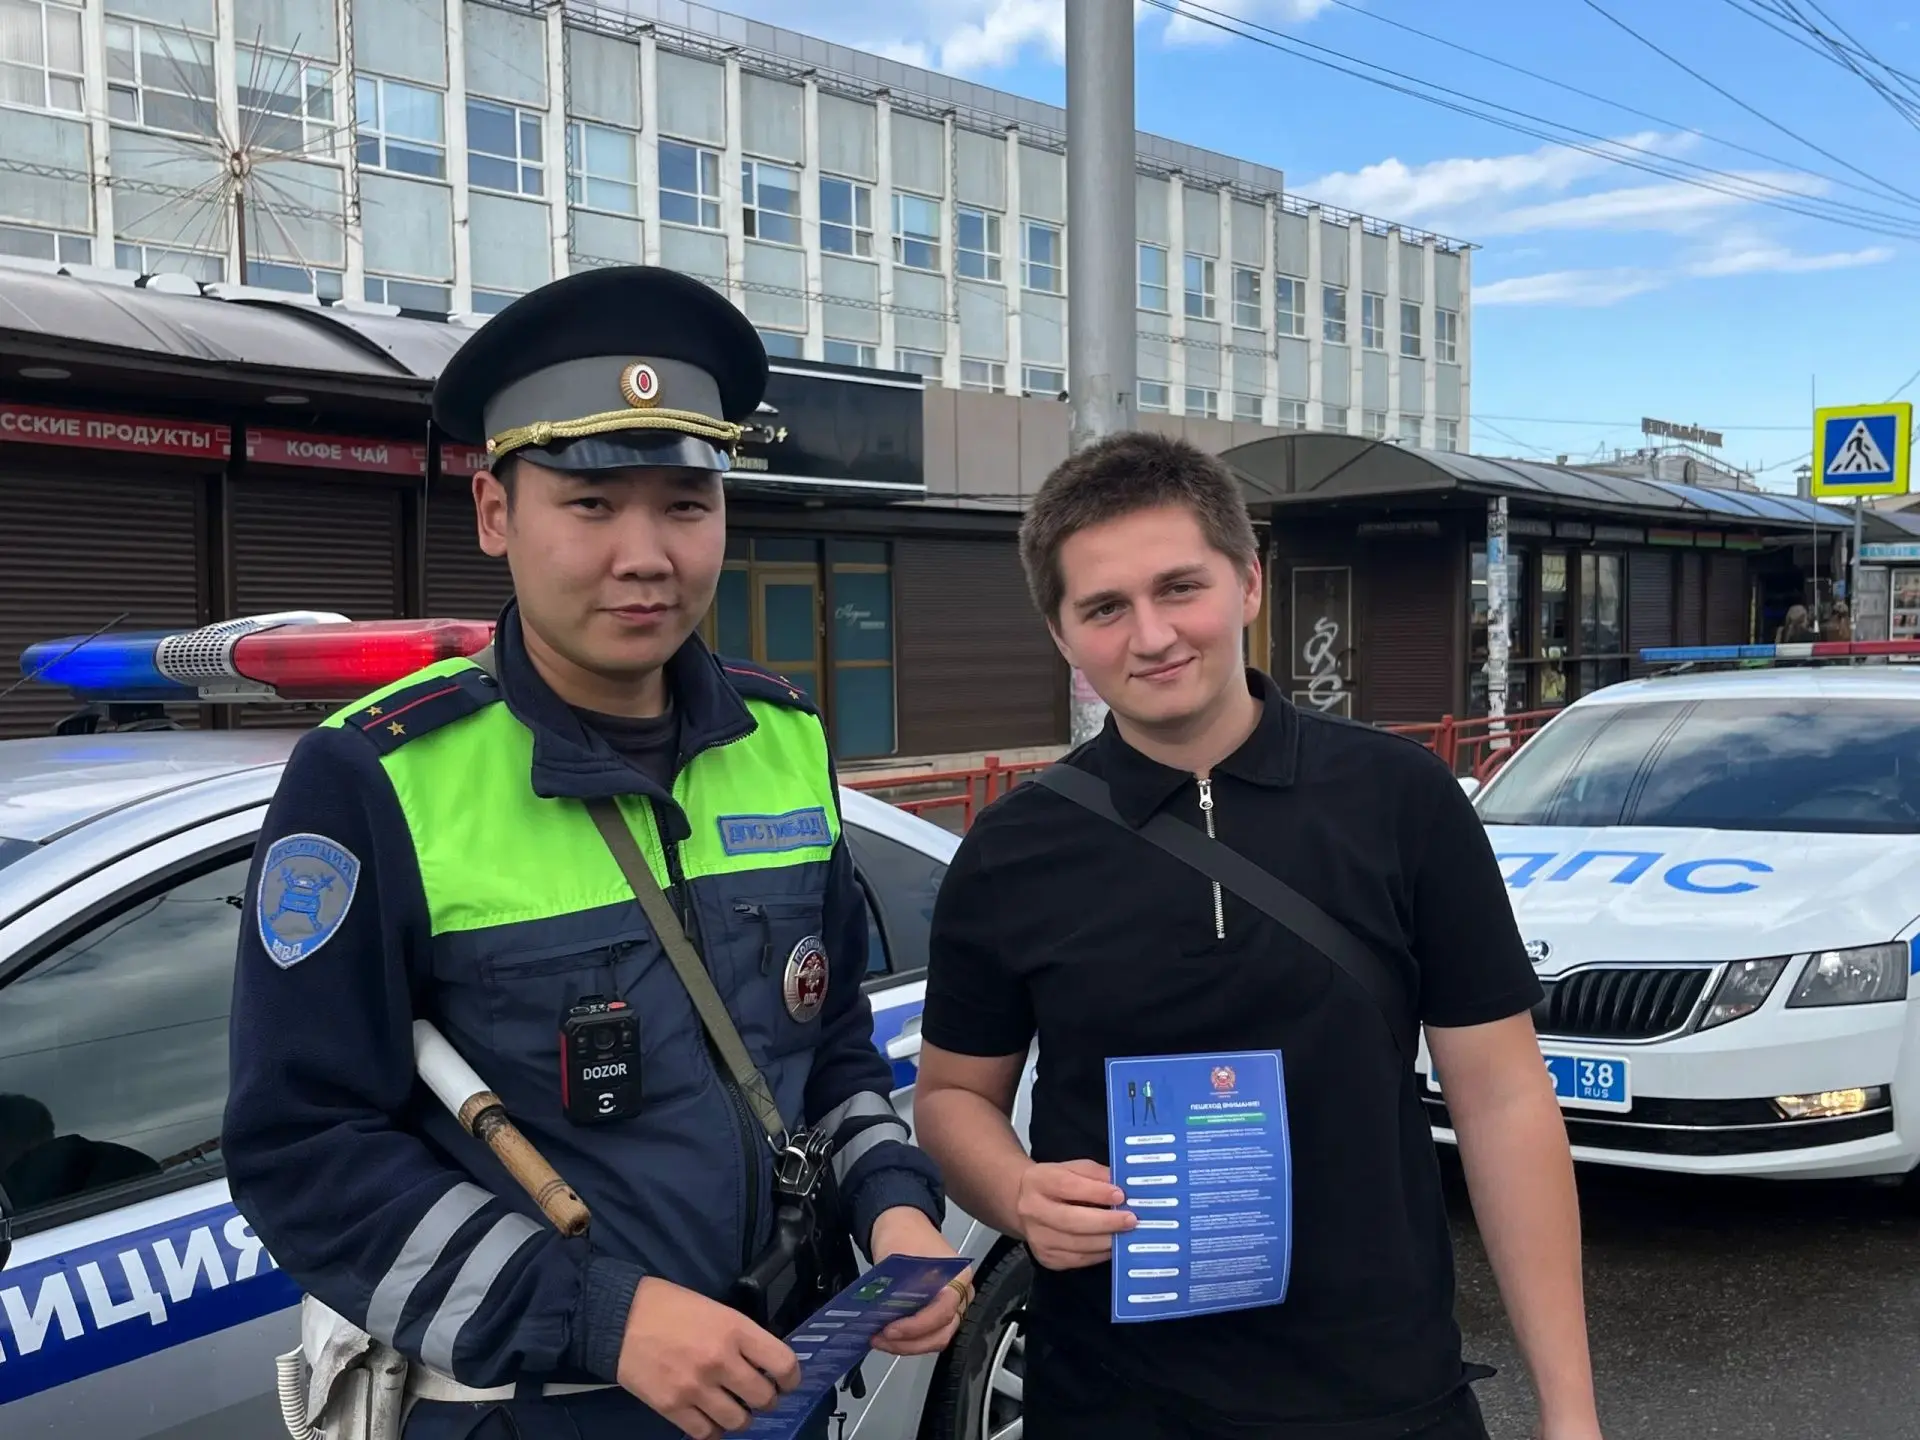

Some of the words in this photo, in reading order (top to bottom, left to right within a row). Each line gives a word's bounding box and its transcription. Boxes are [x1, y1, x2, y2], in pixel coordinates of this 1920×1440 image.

[86, 418, 211, 449] ПРОДУКТЫ
[286, 439, 342, 460] КОФЕ
[350, 442, 389, 465] ЧАЙ
[271, 938, 303, 960] МВД
[583, 1063, 628, 1081] DOZOR
[1580, 1061, 1614, 1088] 38
[1584, 1087, 1609, 1098] RUS
[0, 1214, 279, 1365] ИЦИЯ
